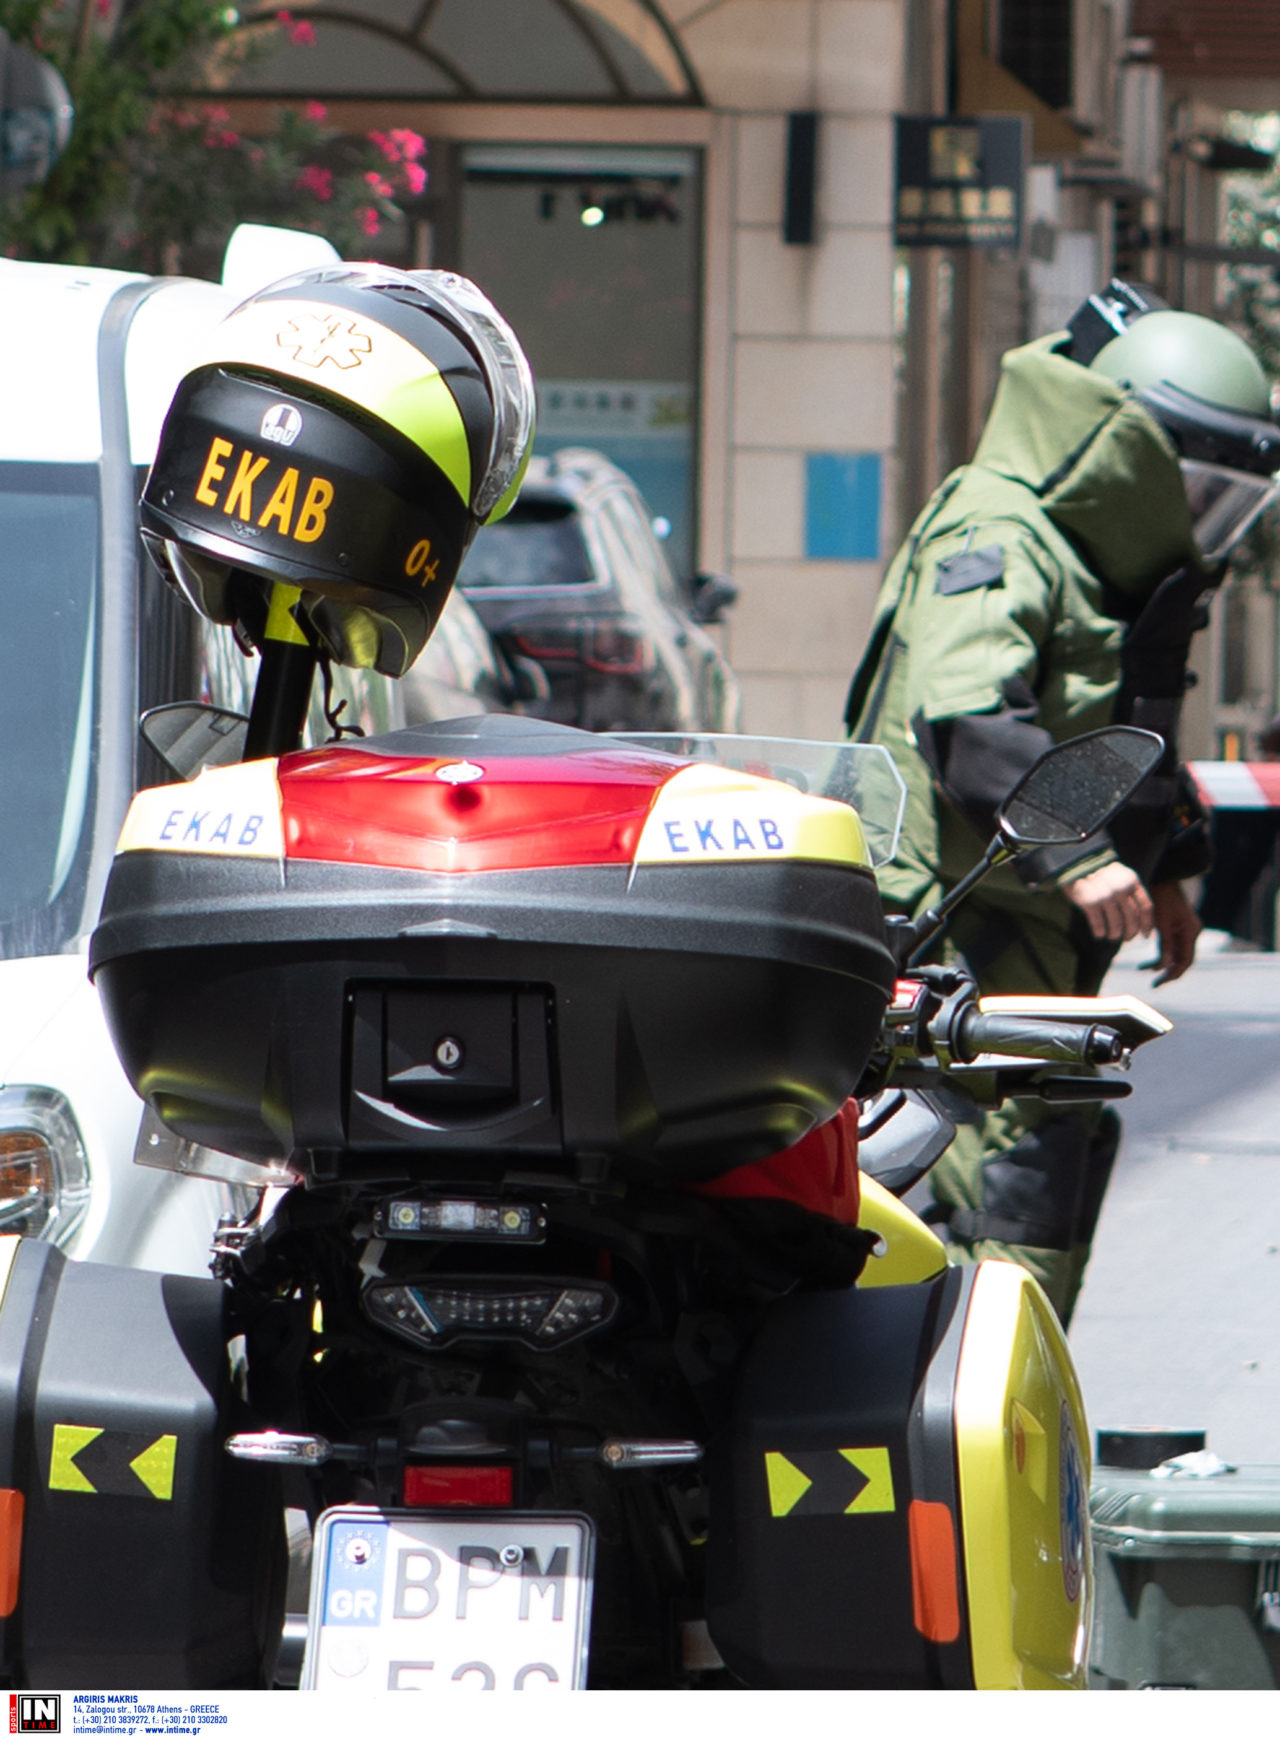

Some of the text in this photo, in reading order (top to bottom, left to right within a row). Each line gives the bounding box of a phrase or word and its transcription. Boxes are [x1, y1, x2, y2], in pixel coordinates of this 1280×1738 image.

[195, 436, 335, 544] EKAB
[159, 810, 264, 846] EKAB
[664, 818, 784, 853] EKAB
[393, 1546, 571, 1621] BPM
[330, 1589, 377, 1619] GR
